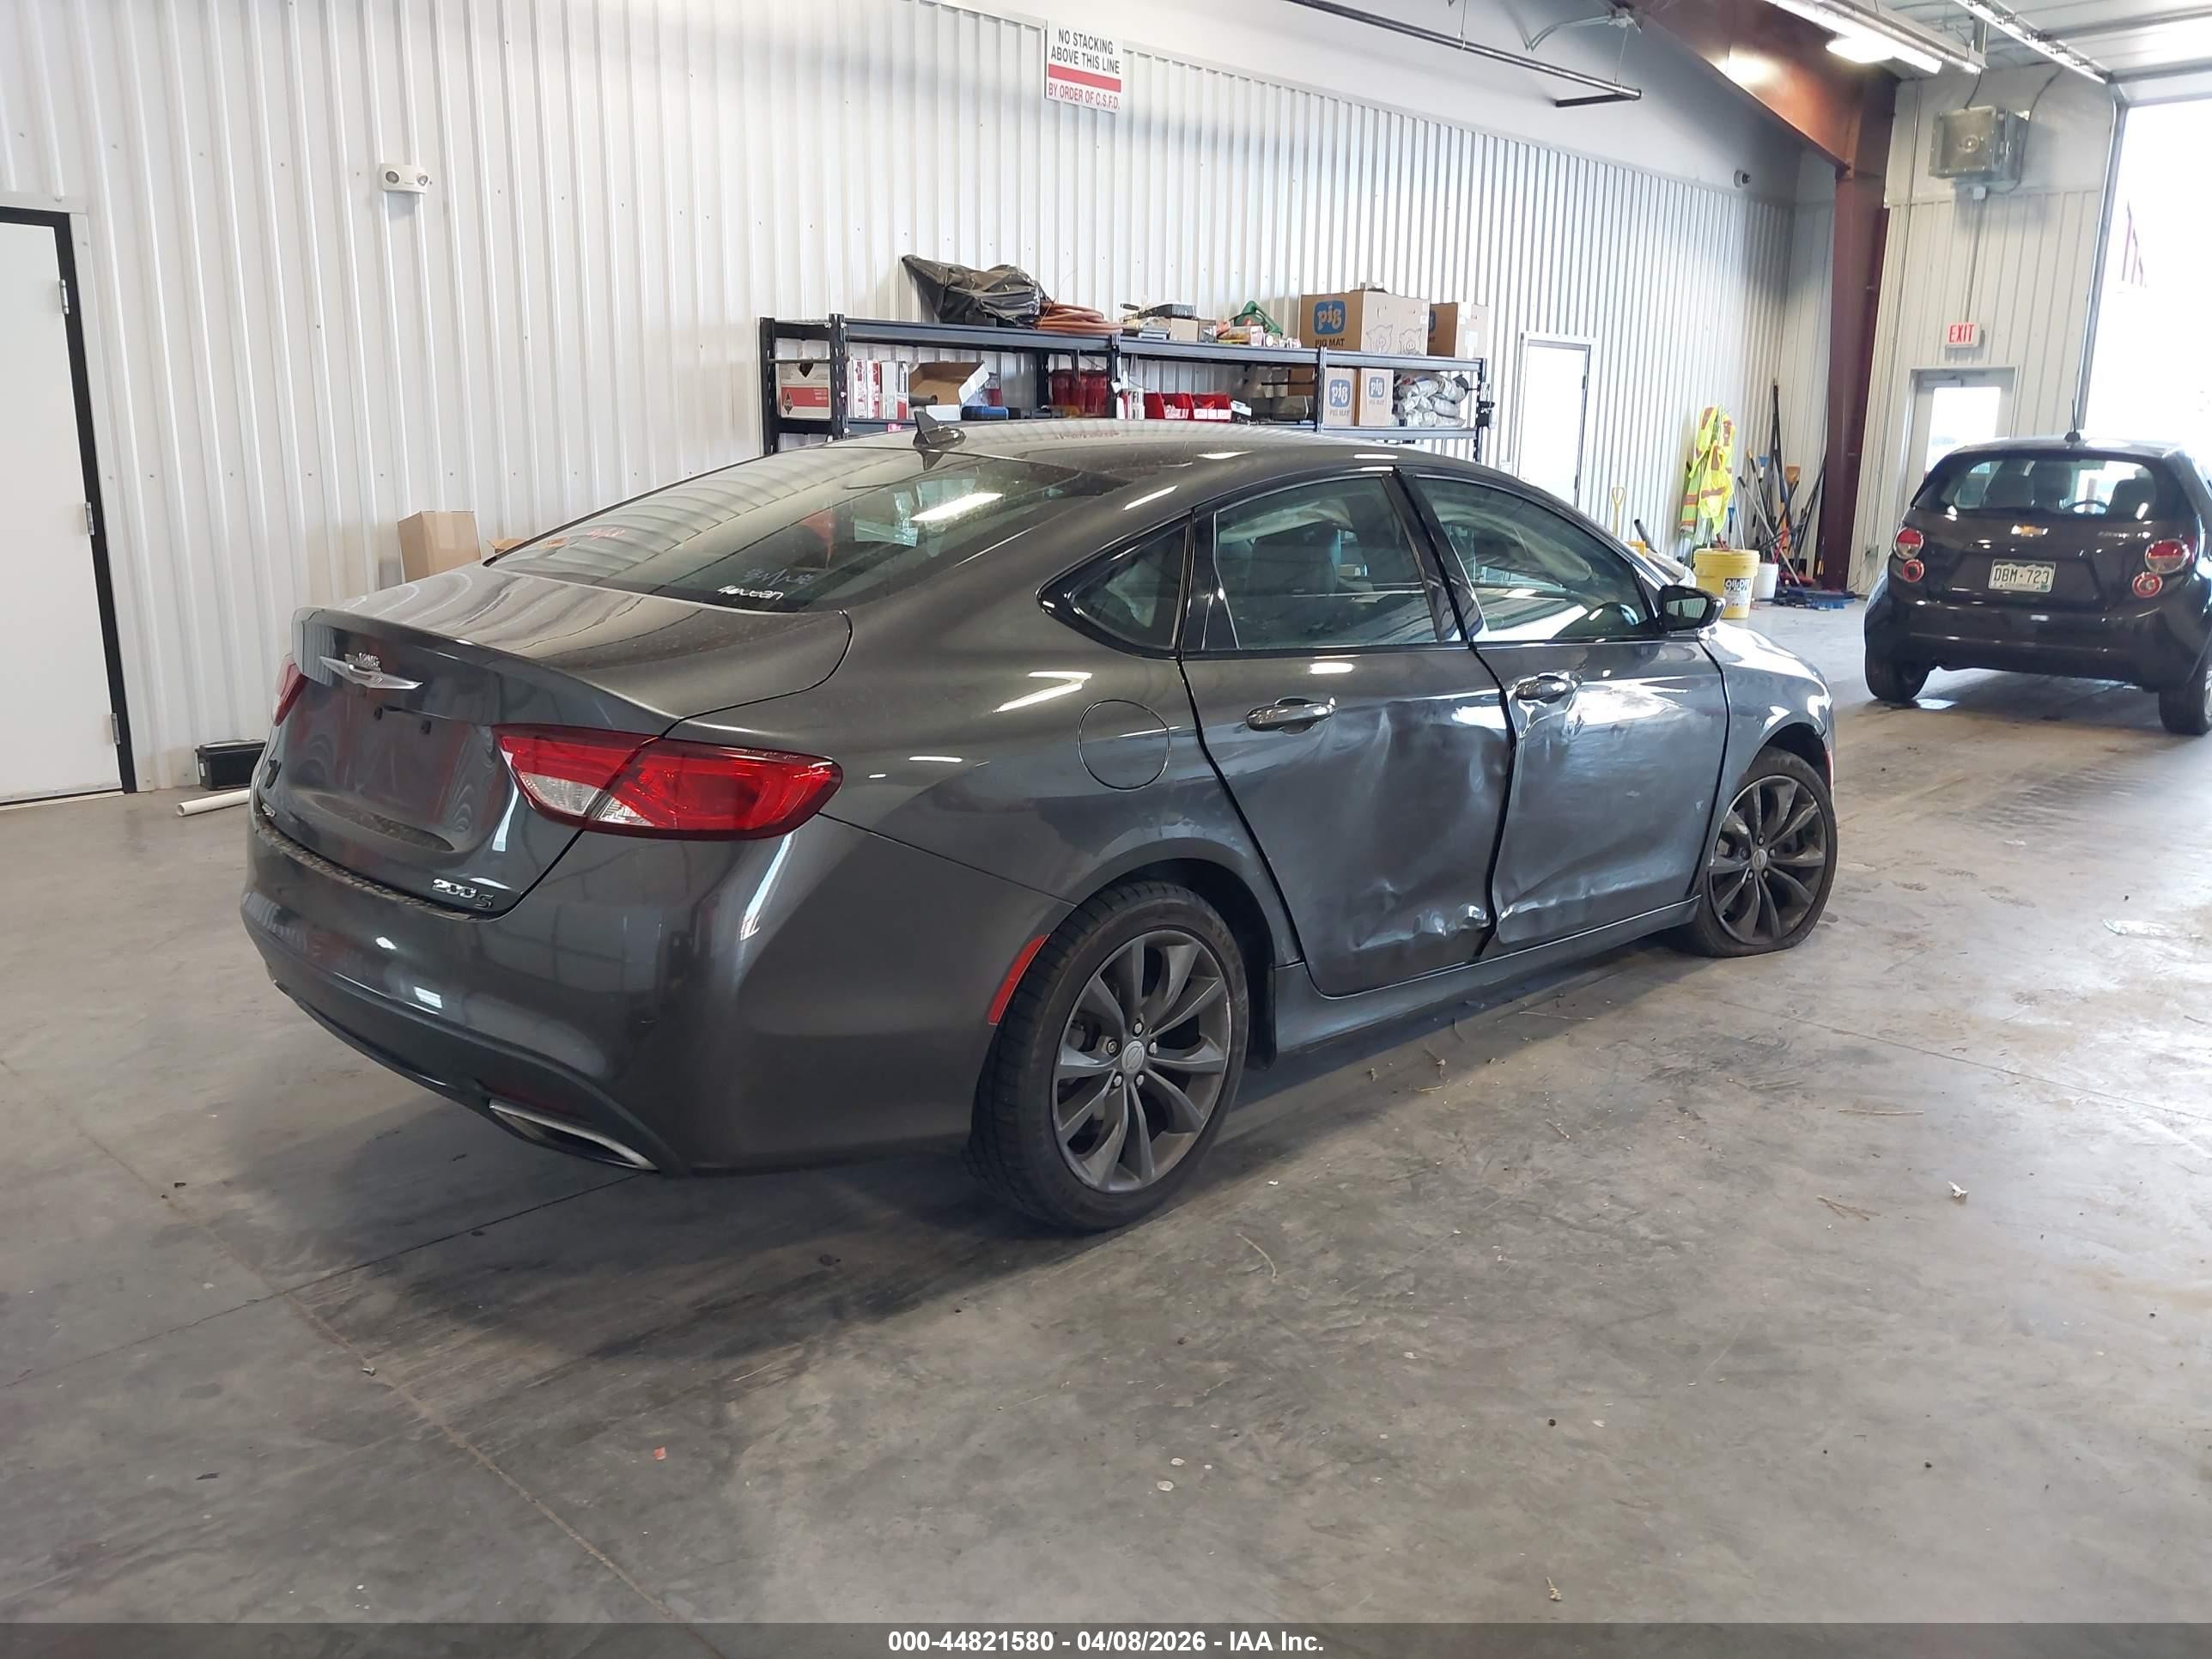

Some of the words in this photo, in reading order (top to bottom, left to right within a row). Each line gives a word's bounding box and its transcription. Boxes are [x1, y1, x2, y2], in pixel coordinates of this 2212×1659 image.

[1059, 28, 1070, 45] NO
[1073, 32, 1114, 55] STACKING
[1051, 46, 1079, 65] ABOVE
[1082, 52, 1100, 70] THIS
[1103, 58, 1120, 74] LINE
[1049, 82, 1057, 97] BY
[1060, 85, 1083, 102] ORDER
[1085, 90, 1094, 103] OF
[1096, 92, 1120, 110] C.S.F.D.
[1317, 305, 1341, 331] pig
[1315, 339, 1328, 348] PIG
[1329, 338, 1345, 347] MAT
[1949, 324, 1974, 343] EXIT
[1331, 382, 1348, 404] pig
[433, 878, 477, 899] 200
[474, 894, 495, 910] S
